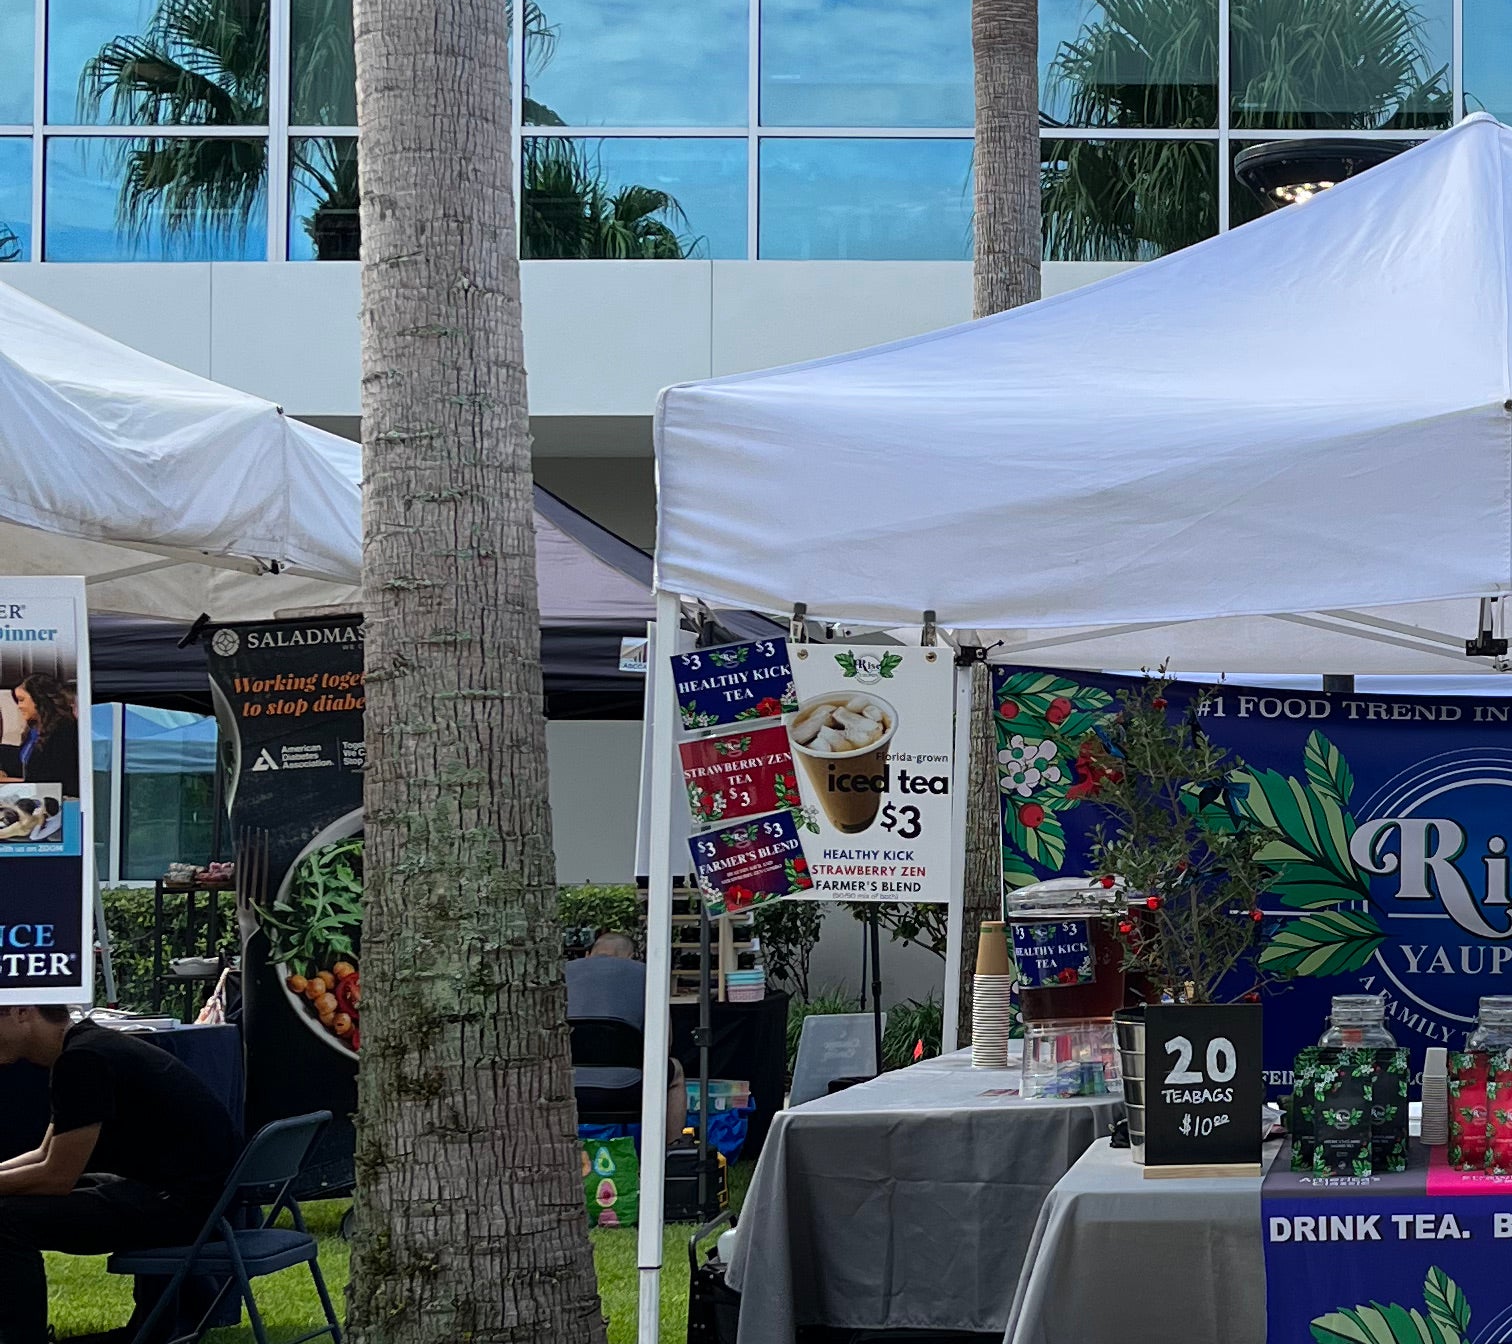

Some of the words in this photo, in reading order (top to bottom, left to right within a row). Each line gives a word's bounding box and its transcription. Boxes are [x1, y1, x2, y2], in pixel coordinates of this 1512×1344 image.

[755, 640, 776, 657] $3
[681, 654, 702, 670] $3
[233, 672, 319, 694] Working
[678, 670, 749, 694] HEALTHY
[752, 664, 791, 681] KICK
[722, 688, 754, 702] TEA
[242, 701, 263, 717] to
[265, 698, 309, 717] stop
[1196, 696, 1227, 717] #1
[1237, 696, 1332, 719] FOOD
[1341, 701, 1463, 721] TREND
[1472, 706, 1511, 721] IN
[683, 756, 764, 779] STRAWBERRY
[767, 751, 792, 765] ZEN
[727, 773, 753, 786] TEA
[828, 763, 890, 793] iced
[897, 769, 949, 795] tea
[729, 787, 751, 807] $3
[880, 800, 922, 839] $3
[763, 821, 784, 838] $3
[697, 841, 717, 857] $3
[698, 849, 757, 875] FARMER'S
[758, 838, 799, 859] BLEND
[823, 848, 880, 860] HEALTHY
[883, 850, 914, 861] KICK
[811, 864, 897, 876] STRAWBERRY
[901, 866, 926, 877] ZEN
[815, 880, 878, 892] FARMER'S
[881, 881, 922, 893] BLEND
[0, 924, 55, 948] CE
[1062, 920, 1078, 936] $3
[1058, 941, 1088, 954] KICK
[0, 952, 72, 977] TER
[1035, 959, 1058, 969] TEA
[1359, 975, 1376, 991] A
[1379, 987, 1457, 1043] FAMILY
[1164, 1035, 1237, 1085] 20
[1161, 1088, 1234, 1104] TEABAGS
[1269, 1214, 1382, 1243] DRINK
[1391, 1213, 1471, 1240] TEA.
